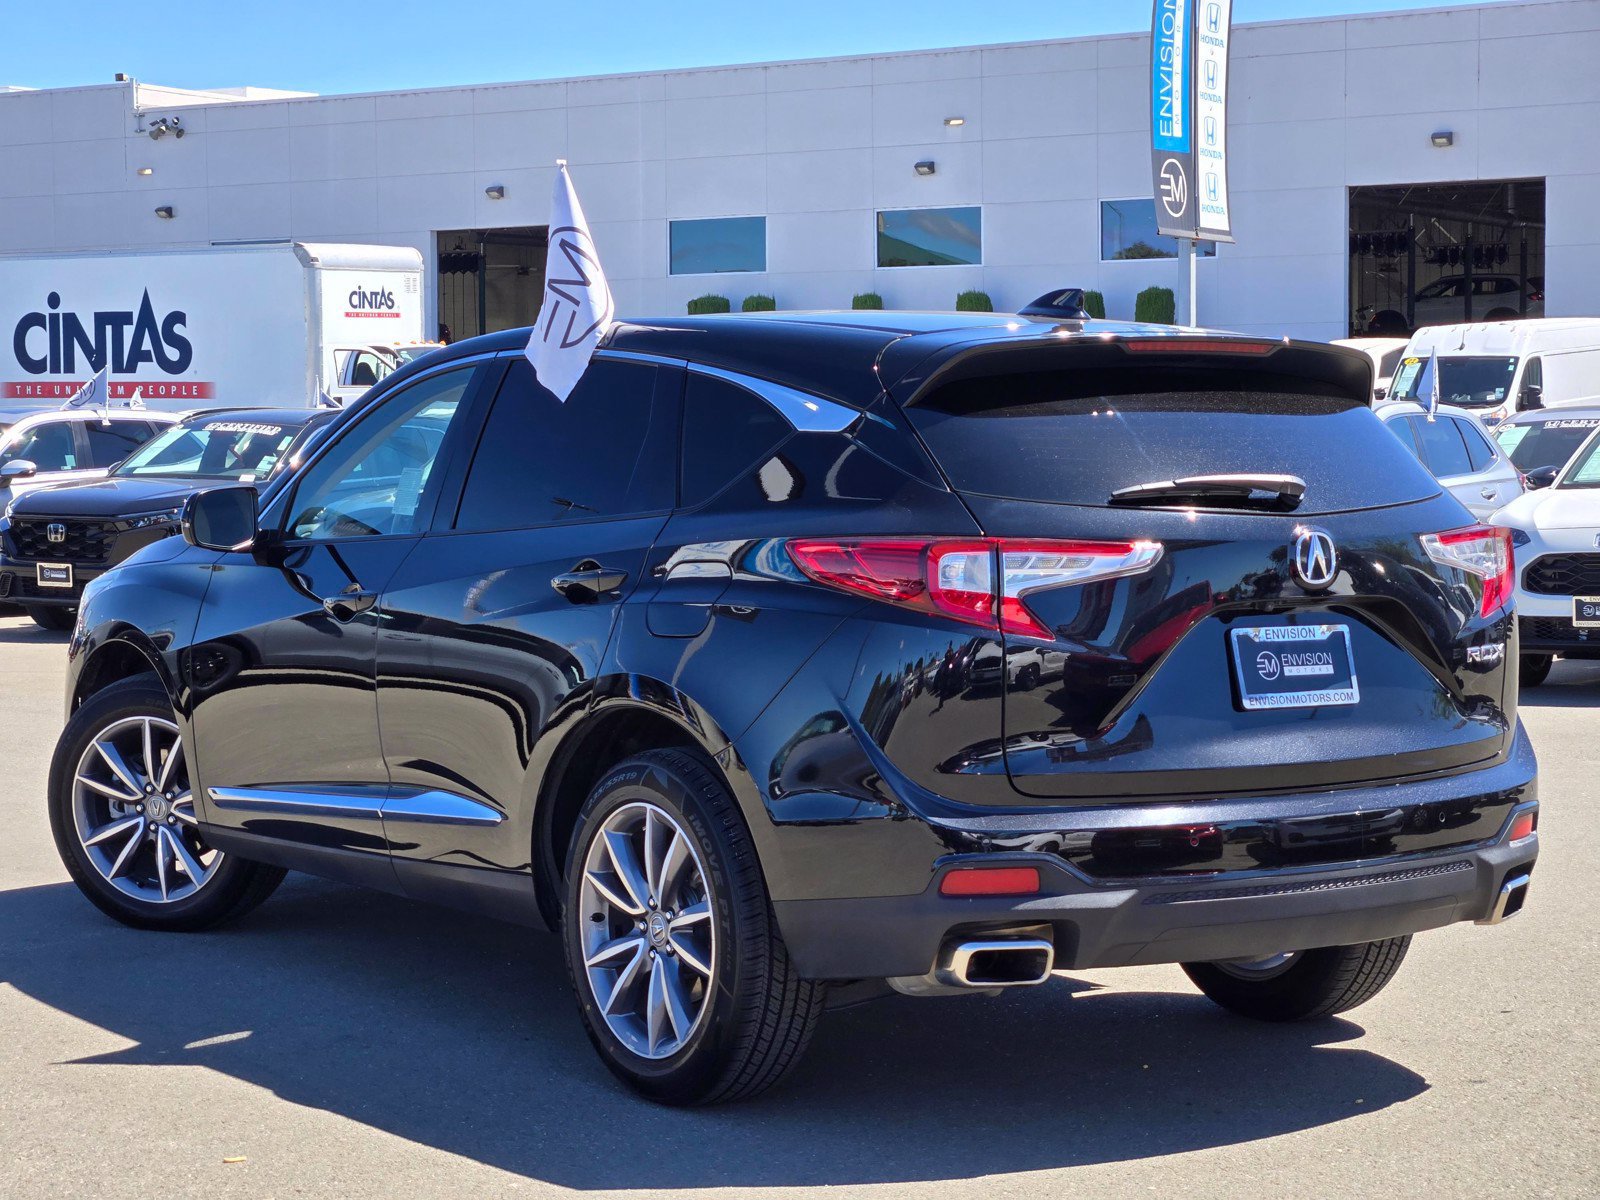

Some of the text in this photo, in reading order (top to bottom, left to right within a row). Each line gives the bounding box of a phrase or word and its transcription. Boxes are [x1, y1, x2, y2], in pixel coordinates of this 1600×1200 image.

[1200, 34, 1224, 48] HONDA
[1200, 91, 1223, 104] HONDA
[1200, 147, 1223, 160] HONDA
[1201, 203, 1225, 216] HONDA
[16, 385, 199, 395] THE UNRM PEOPLE
[1265, 627, 1317, 640] ENVISION
[1281, 652, 1333, 667] ENVISION
[1467, 643, 1505, 663] RDX
[1249, 691, 1354, 706] ENVISIONMOTORS.COM
